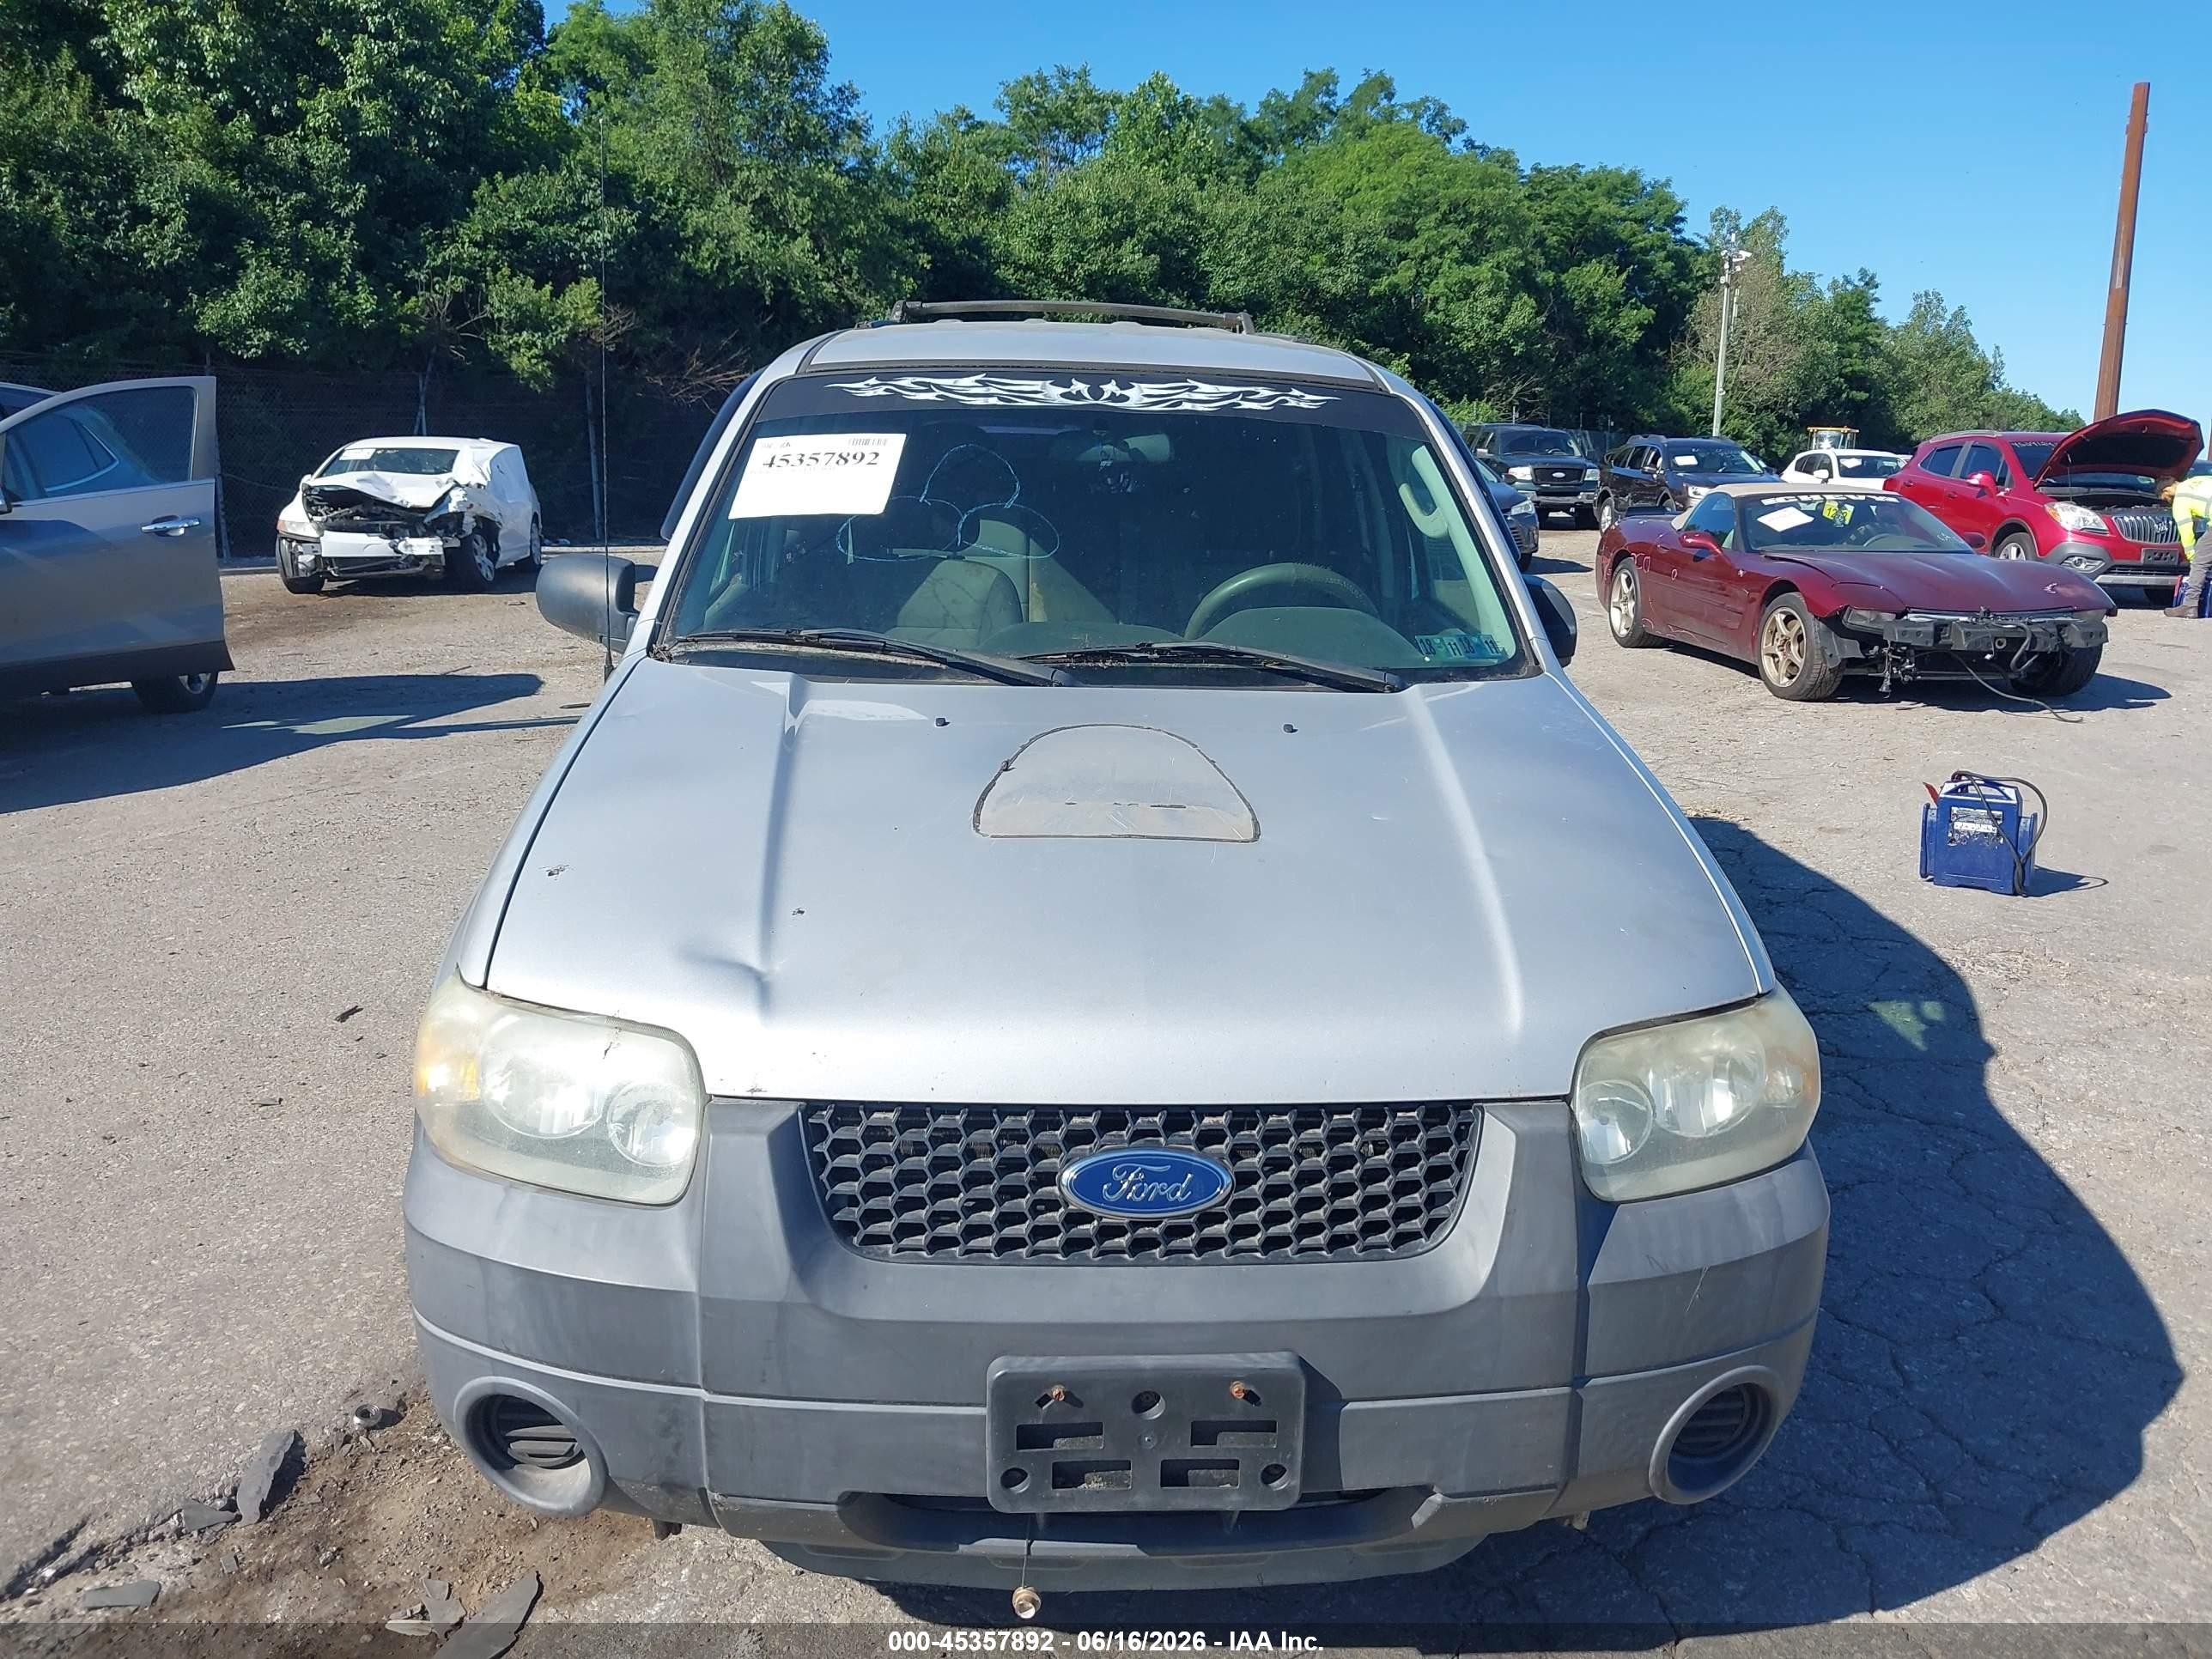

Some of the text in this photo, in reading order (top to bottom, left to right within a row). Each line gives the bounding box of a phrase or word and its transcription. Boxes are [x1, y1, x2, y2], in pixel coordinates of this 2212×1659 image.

[763, 452, 880, 468] 45357892
[1447, 641, 1463, 657] 11
[1484, 639, 1501, 654] 11
[1103, 1162, 1194, 1202] Ford
